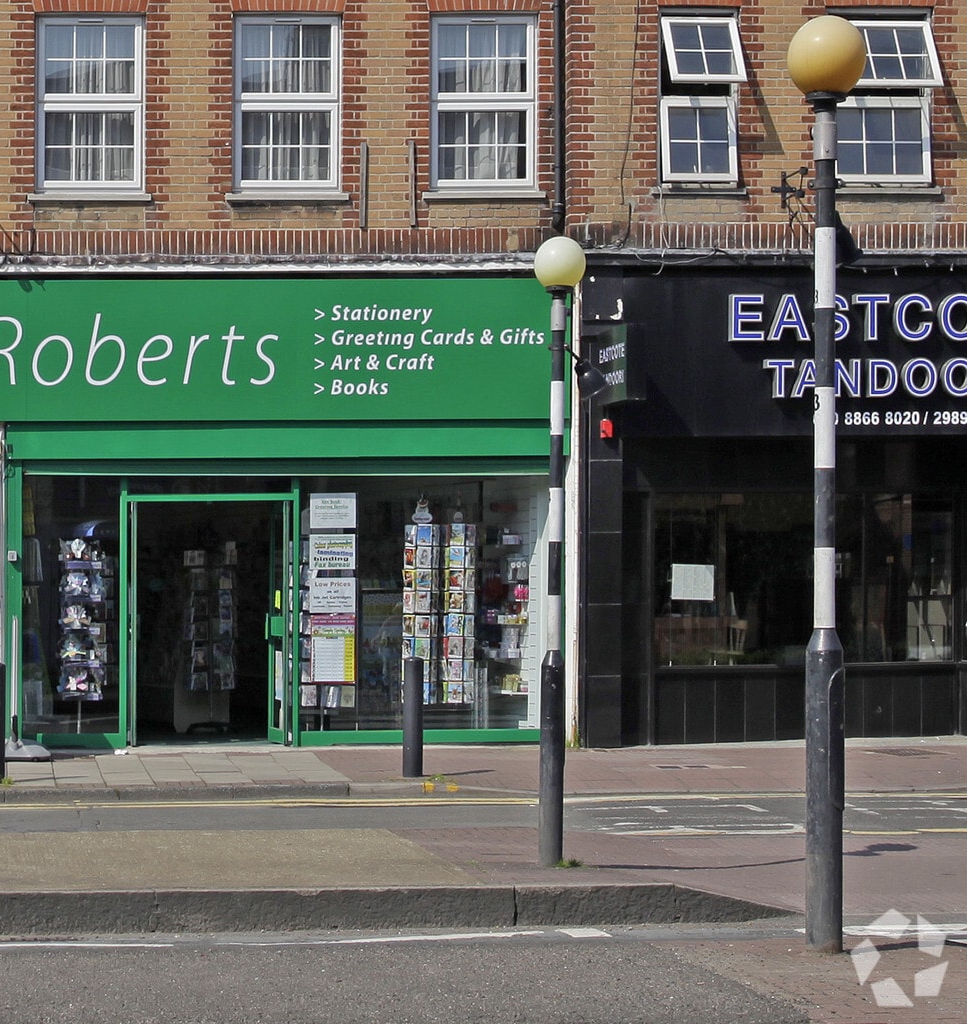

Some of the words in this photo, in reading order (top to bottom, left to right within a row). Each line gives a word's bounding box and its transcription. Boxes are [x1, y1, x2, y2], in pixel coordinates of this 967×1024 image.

[331, 304, 433, 325] Stationery
[331, 329, 415, 350] Greeting
[420, 328, 475, 345] Cards
[479, 328, 494, 345] &
[499, 327, 545, 345] Gifts
[330, 354, 362, 370] Art
[366, 354, 380, 370] &
[385, 353, 435, 370] Craft
[599, 342, 625, 364] EASTCOTE
[330, 378, 389, 395] Books
[763, 358, 967, 398] TANDOO
[844, 411, 880, 425] 8866
[885, 411, 920, 425] 8020
[933, 411, 967, 425] 2989
